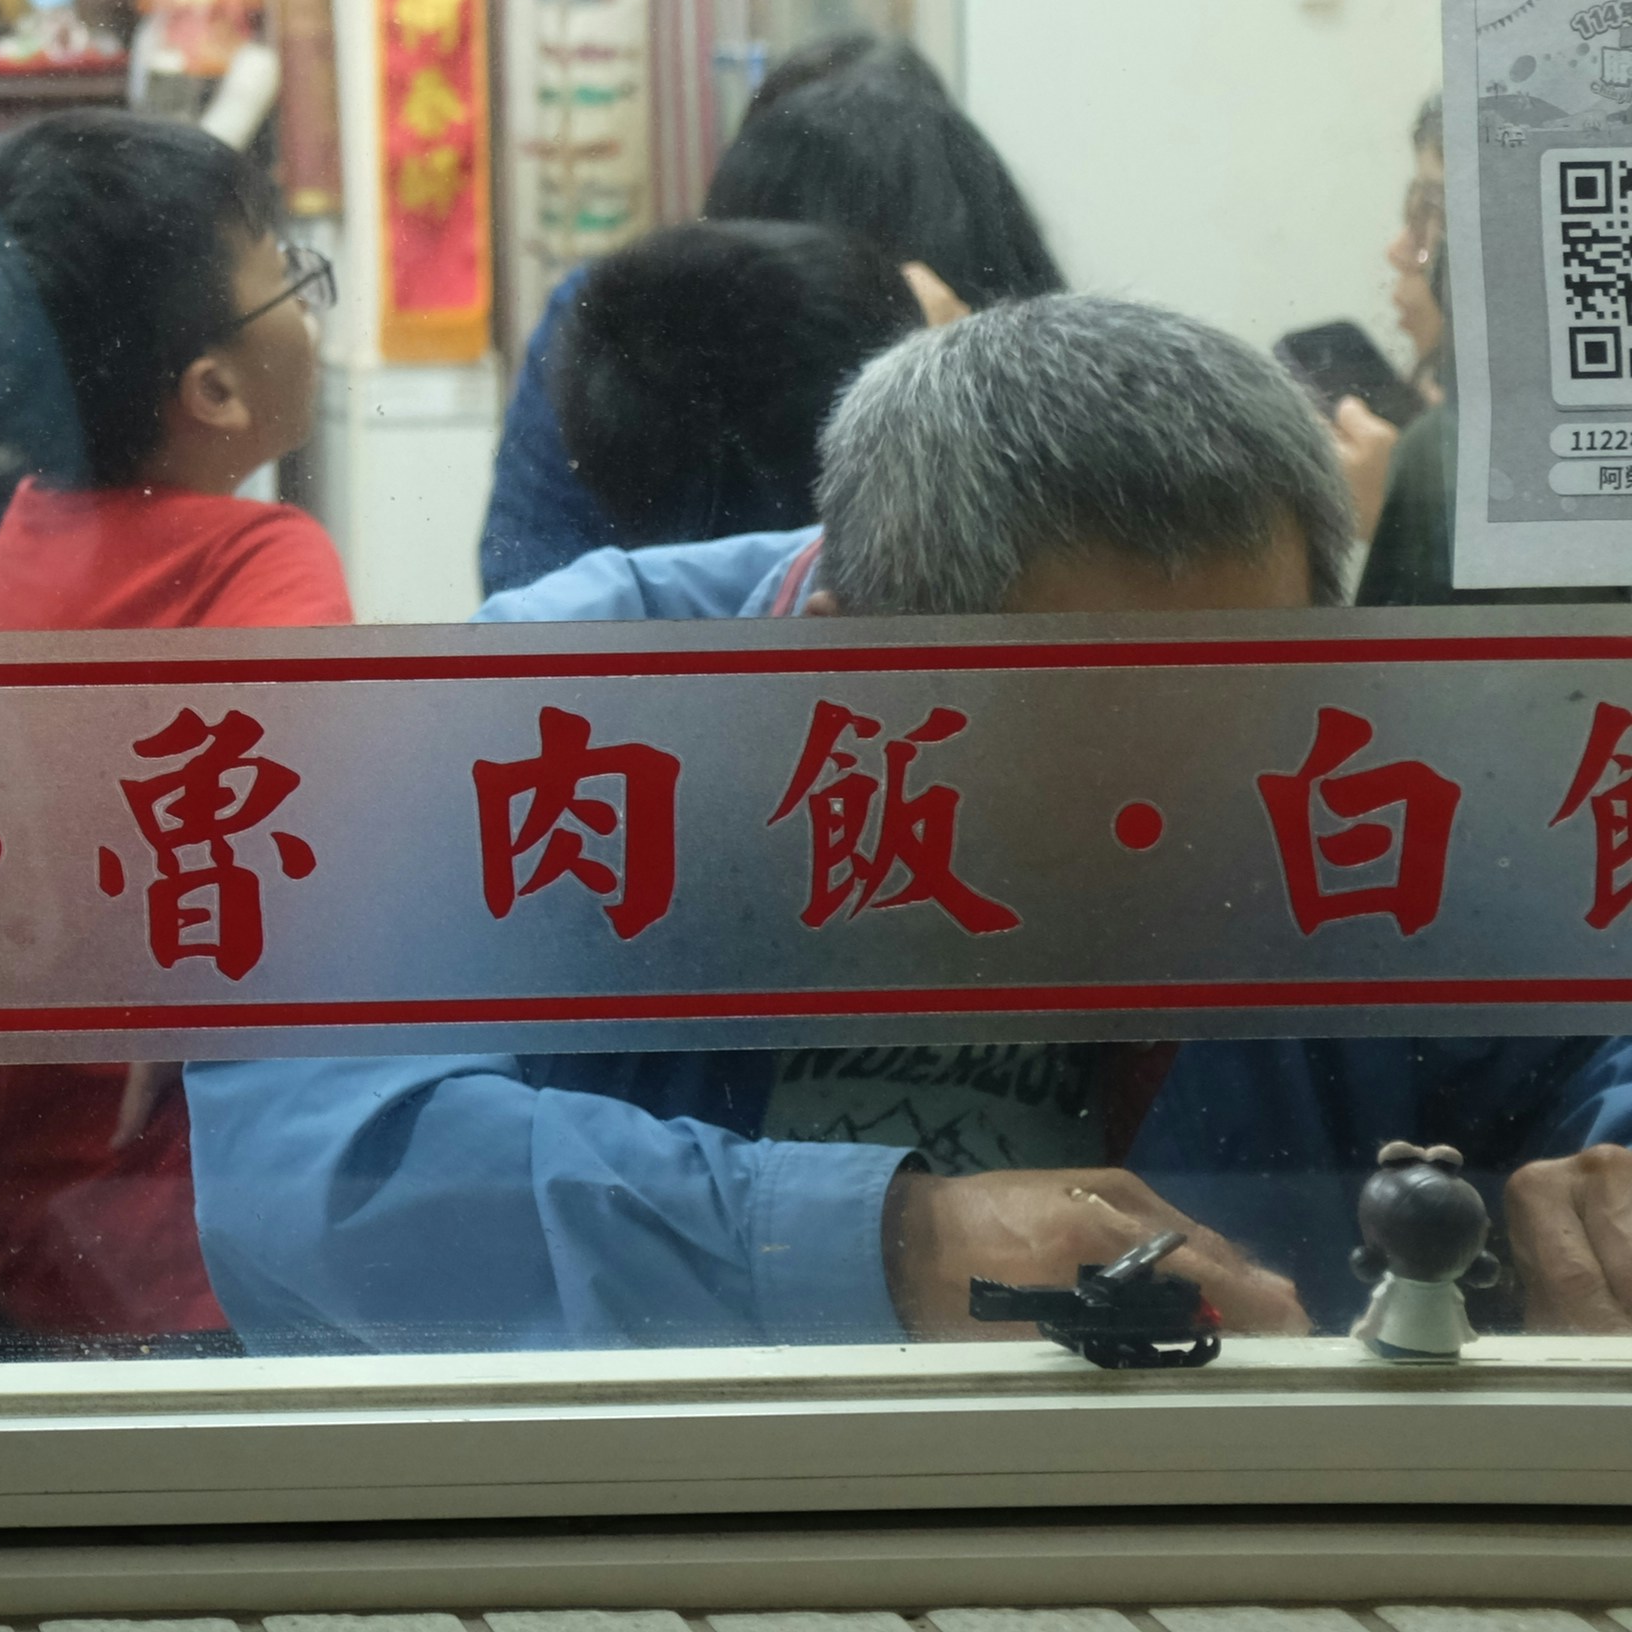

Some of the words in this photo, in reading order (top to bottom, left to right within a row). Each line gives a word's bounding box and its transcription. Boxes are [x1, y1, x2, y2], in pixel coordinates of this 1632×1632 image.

[1571, 430, 1632, 451] 1122
[98, 700, 1021, 981] 魯肉飯
